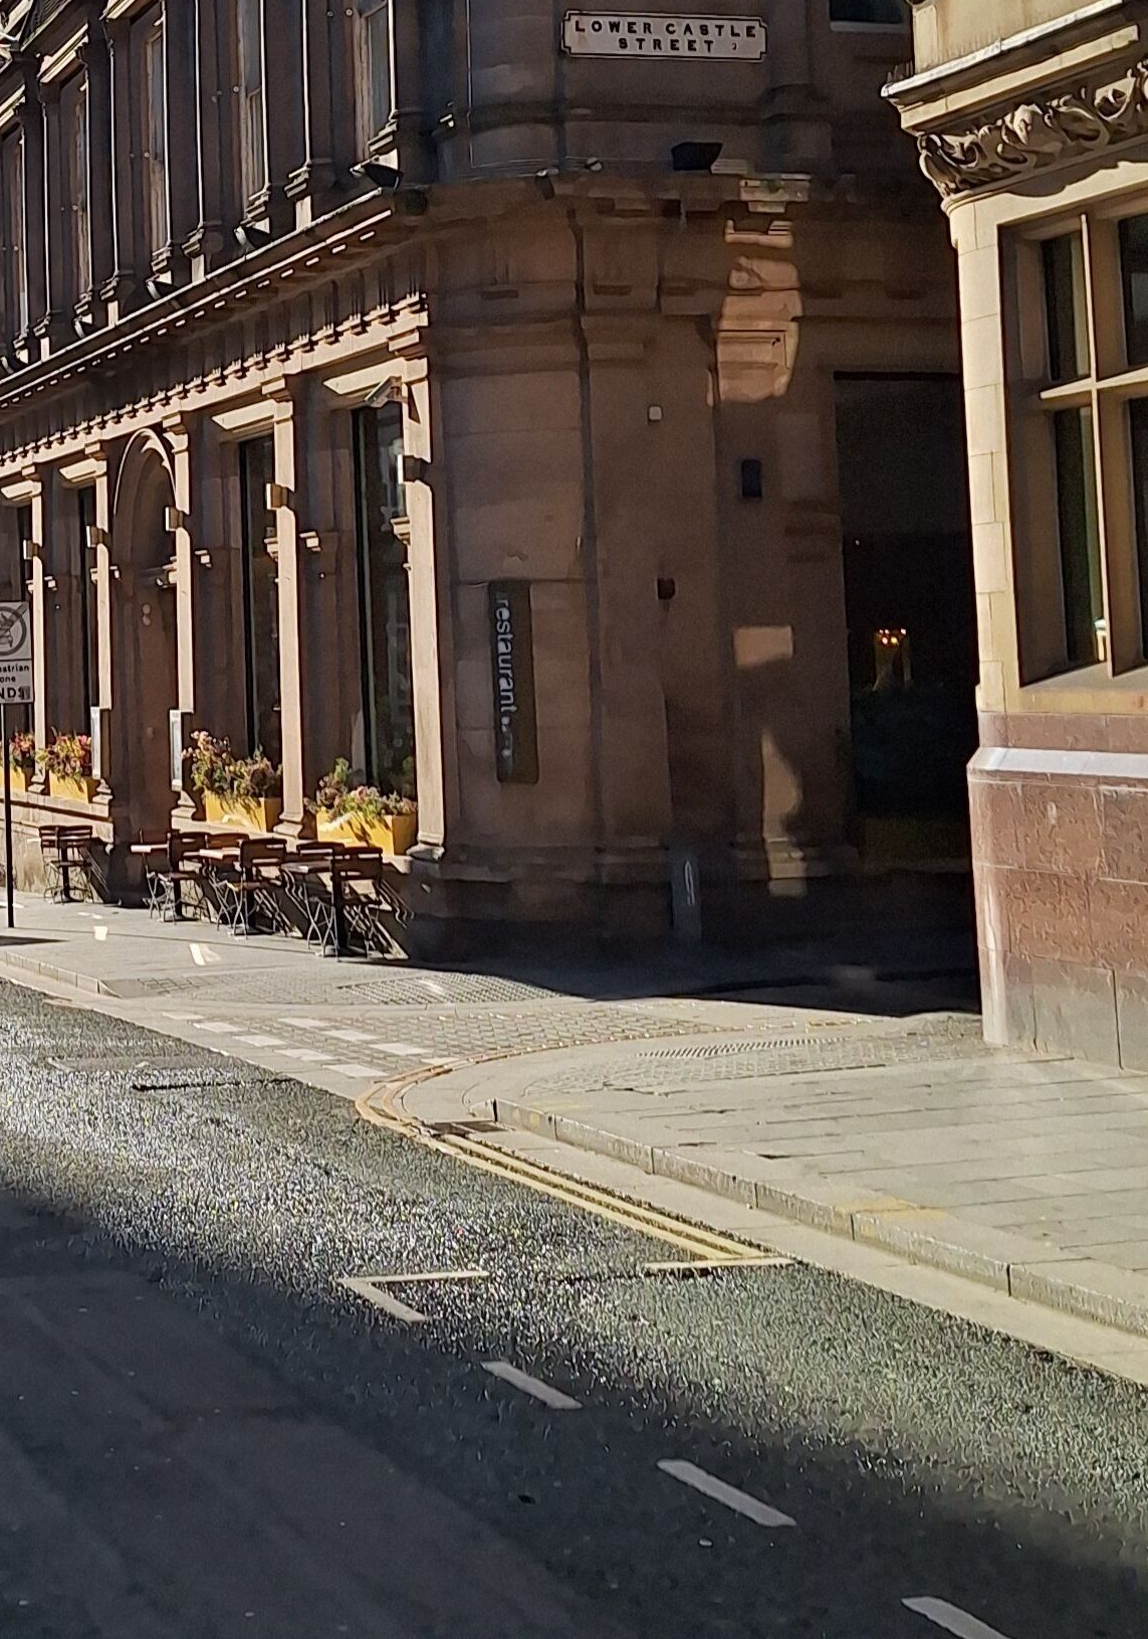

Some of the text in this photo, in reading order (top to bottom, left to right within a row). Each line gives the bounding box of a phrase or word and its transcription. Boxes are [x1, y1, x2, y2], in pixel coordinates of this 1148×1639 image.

[575, 20, 756, 38] LOWER CASTLE
[618, 37, 714, 52] STREET
[496, 599, 518, 712] restaurant
